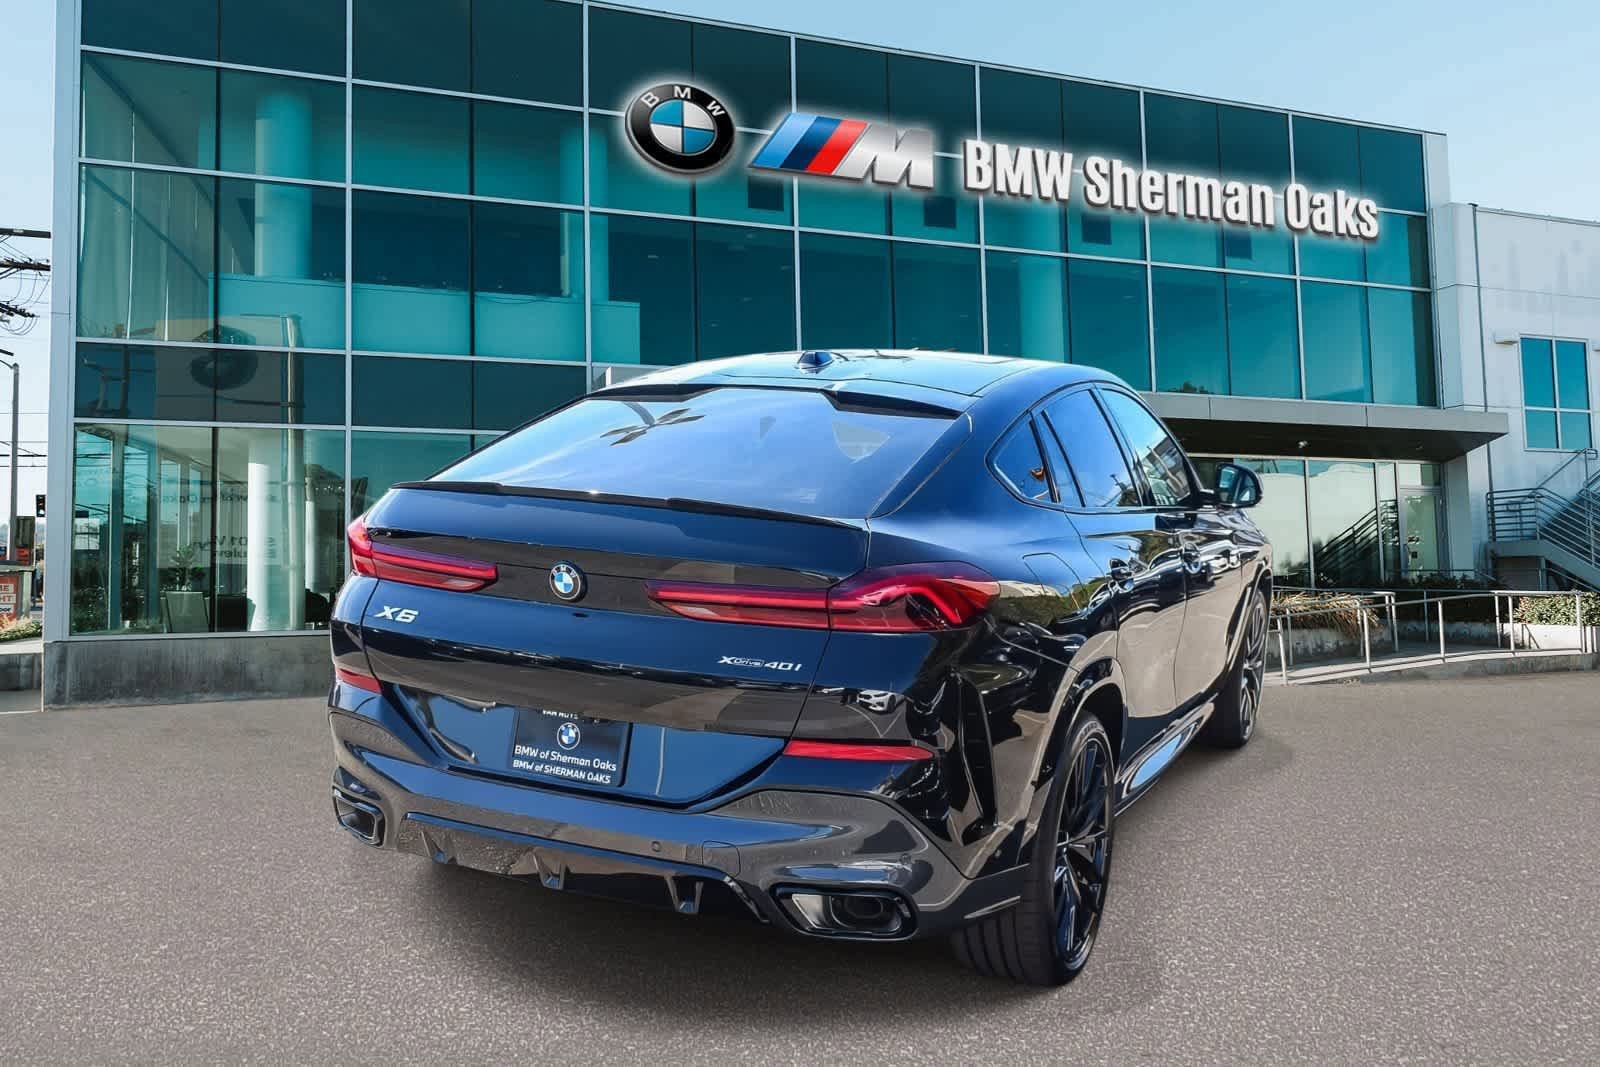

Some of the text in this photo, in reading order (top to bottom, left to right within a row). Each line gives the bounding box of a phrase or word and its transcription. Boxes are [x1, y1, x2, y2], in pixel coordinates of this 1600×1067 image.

[964, 139, 1379, 241] BMW Sherman Oaks
[374, 605, 419, 623] X6
[512, 759, 612, 784] BMW of SHERMAN OAKS
[514, 745, 617, 772] BMW of Sherman Oaks
